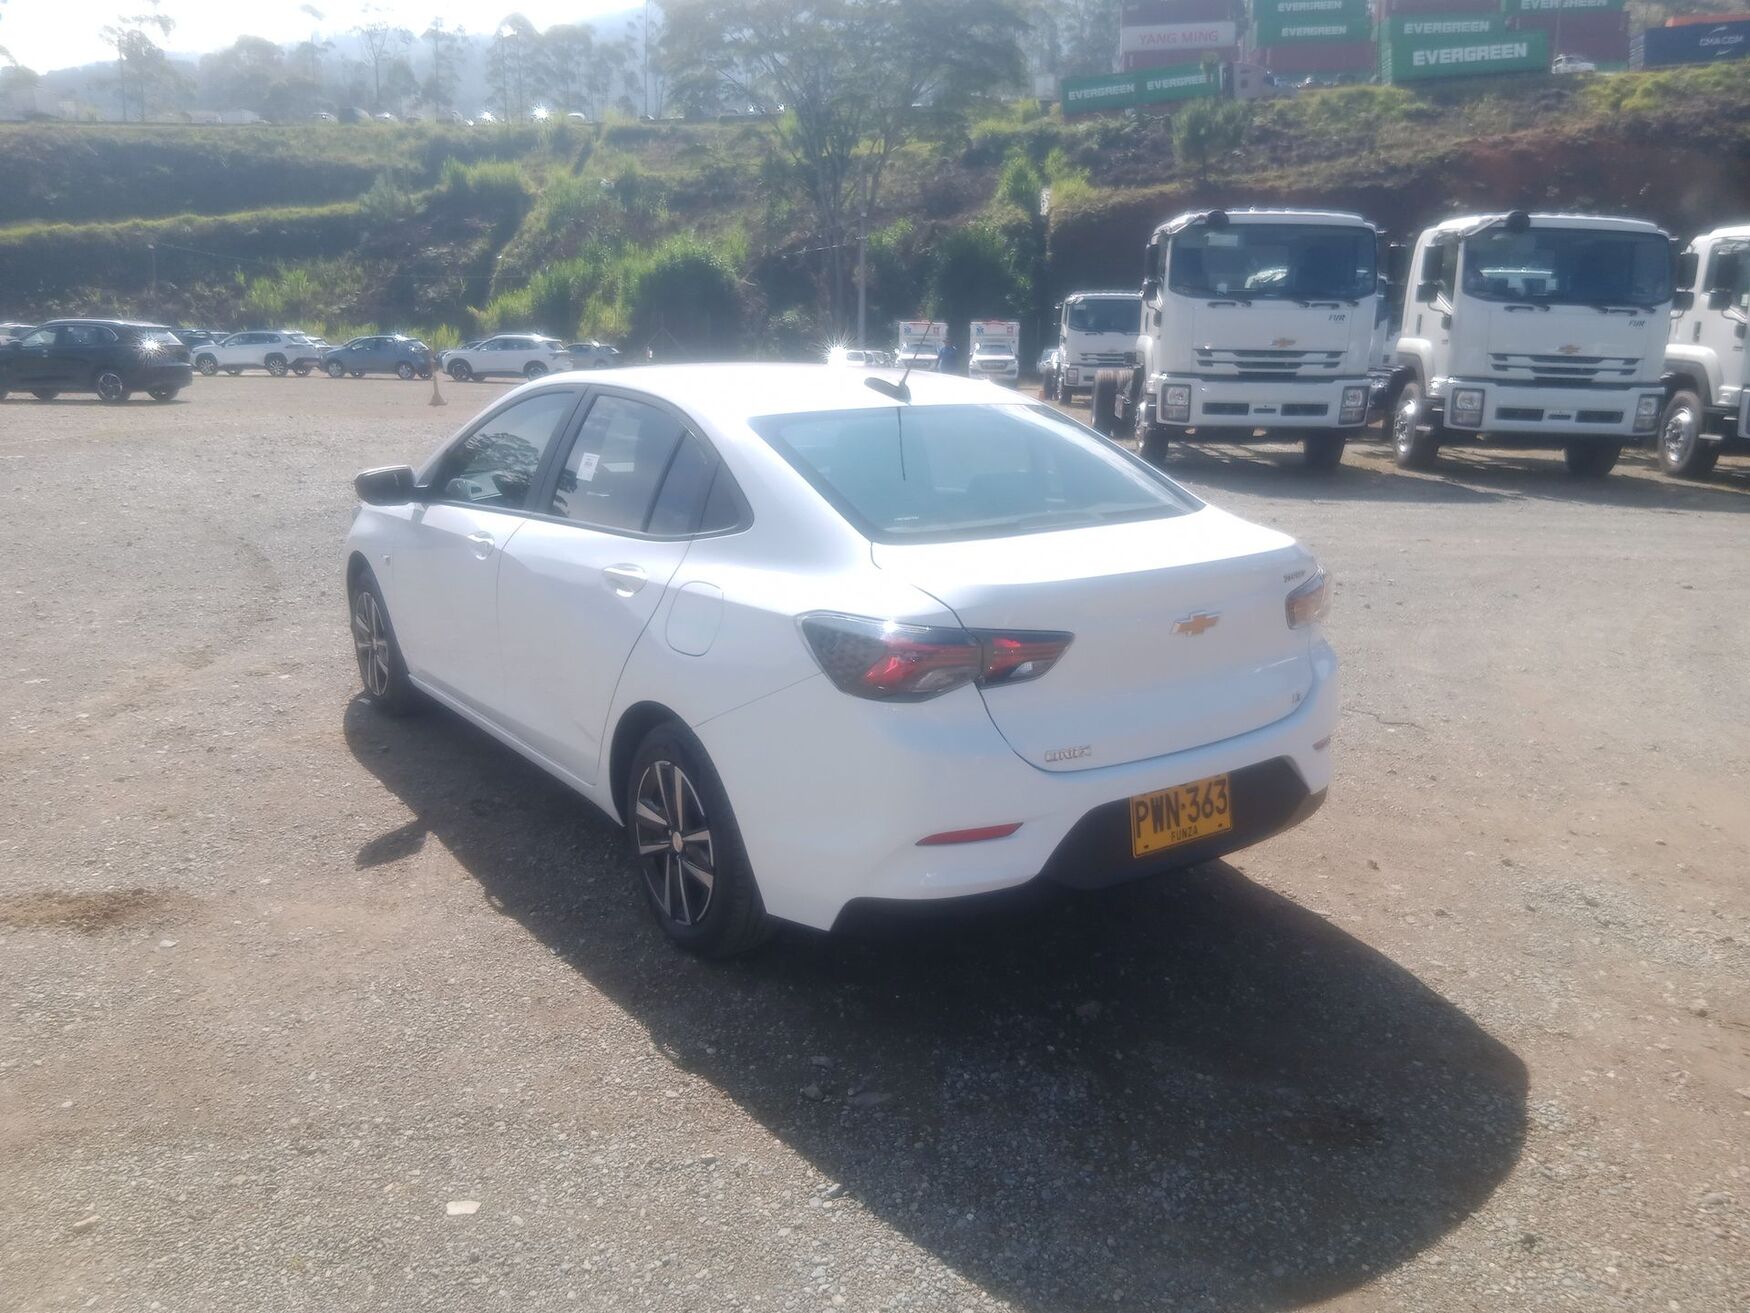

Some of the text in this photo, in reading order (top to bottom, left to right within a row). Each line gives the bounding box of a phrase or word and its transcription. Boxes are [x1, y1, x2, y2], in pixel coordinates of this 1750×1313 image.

[1281, 26, 1346, 36] EVERGREEN
[1404, 21, 1489, 34] EVERGREEN
[1139, 29, 1218, 45] YANG MING
[1413, 42, 1527, 65] EVERGREEN
[1069, 84, 1135, 100] EVERGREEN
[1170, 825, 1198, 841] FUNZA
